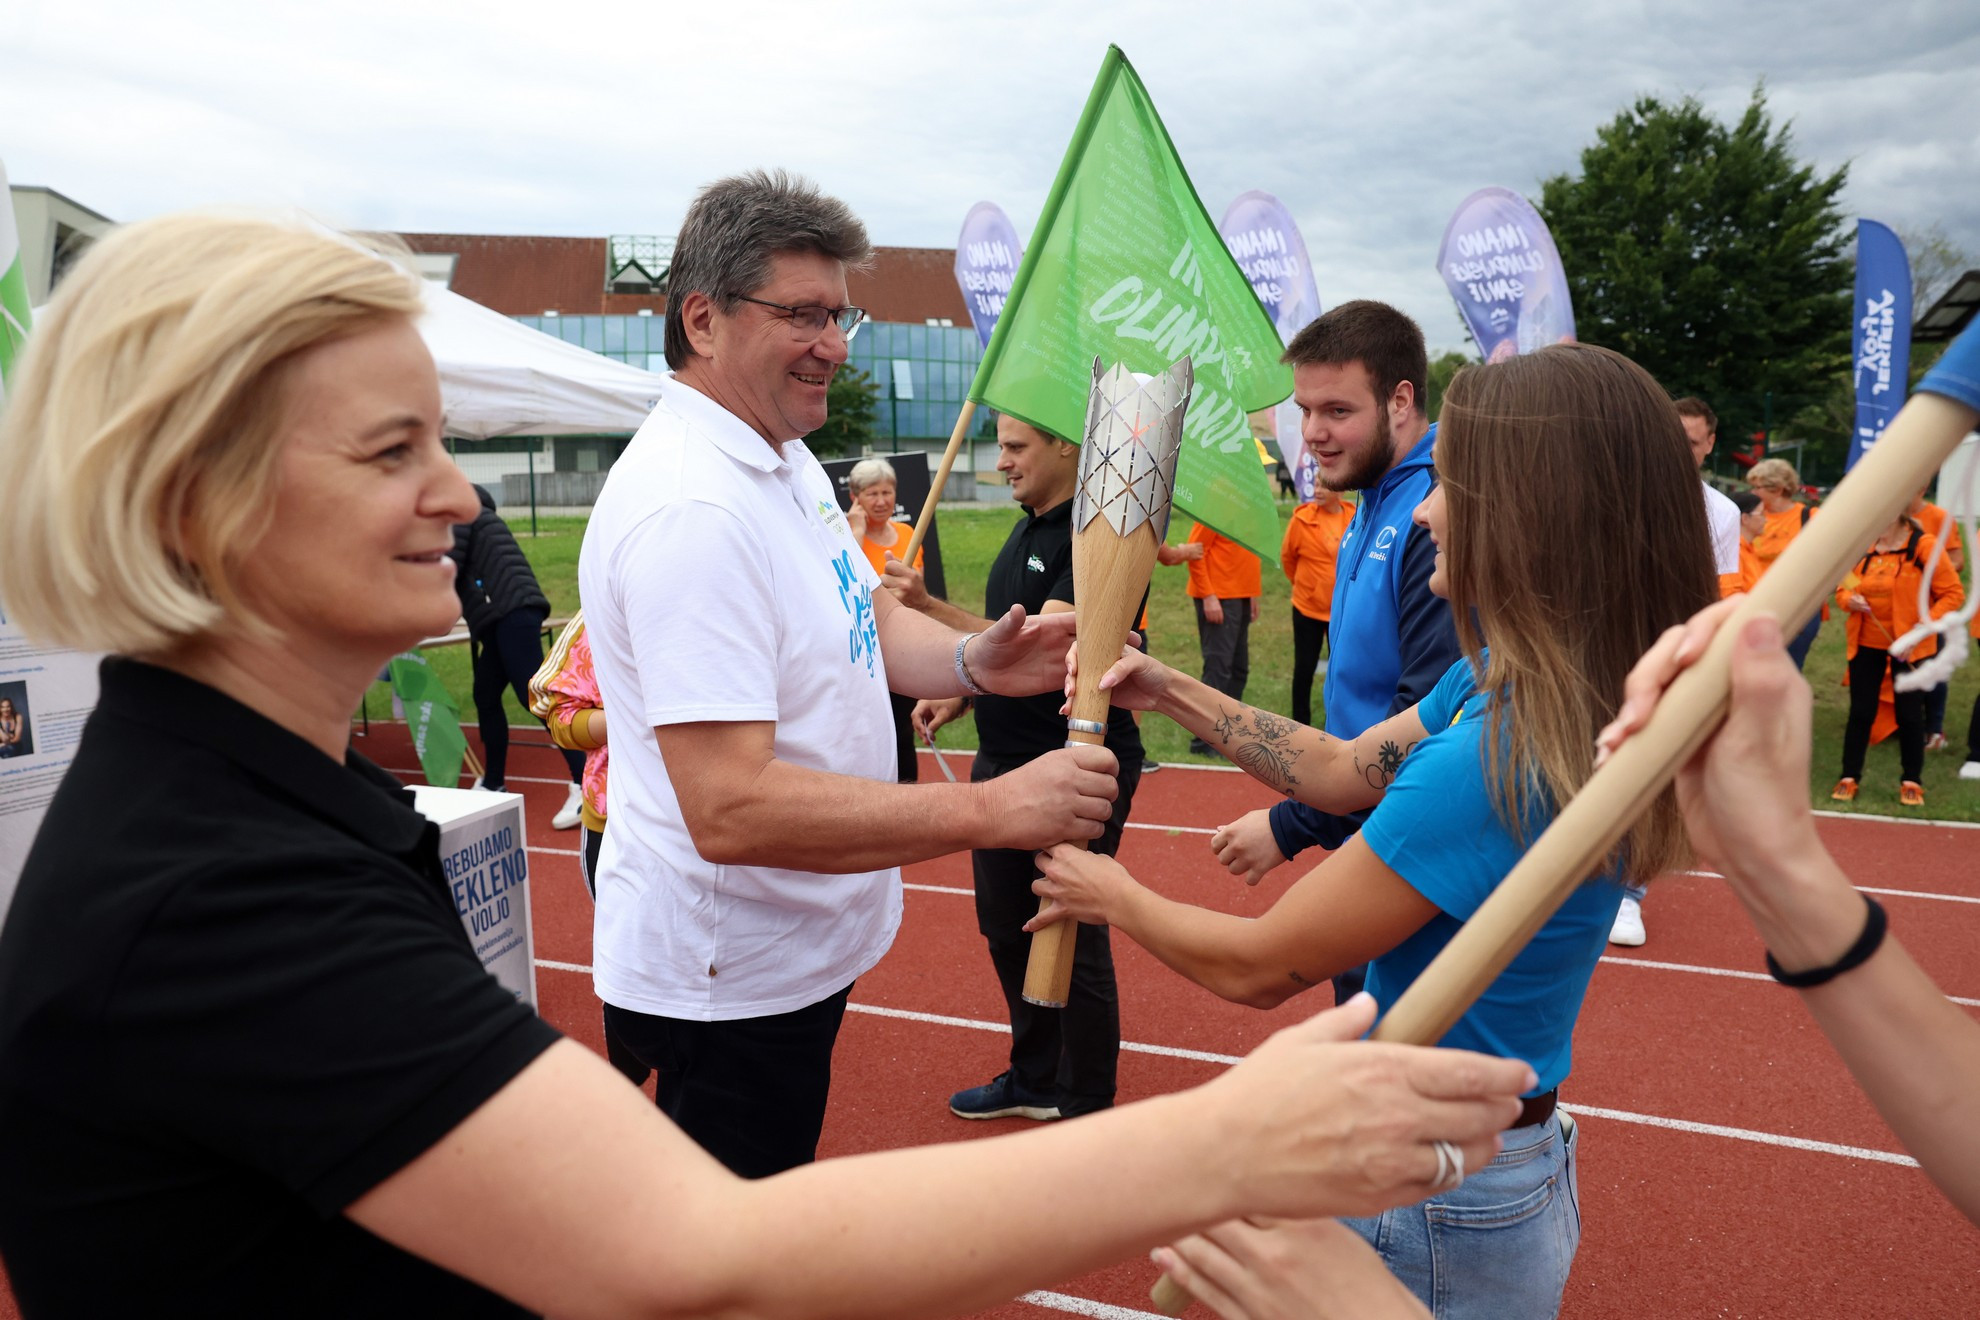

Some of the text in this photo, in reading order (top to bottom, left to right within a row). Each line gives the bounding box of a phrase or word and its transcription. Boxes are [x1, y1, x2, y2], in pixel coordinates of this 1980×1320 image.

[444, 826, 512, 880] REBUJAMO
[453, 848, 527, 916] EKLENO
[471, 896, 510, 937] VOLJO
